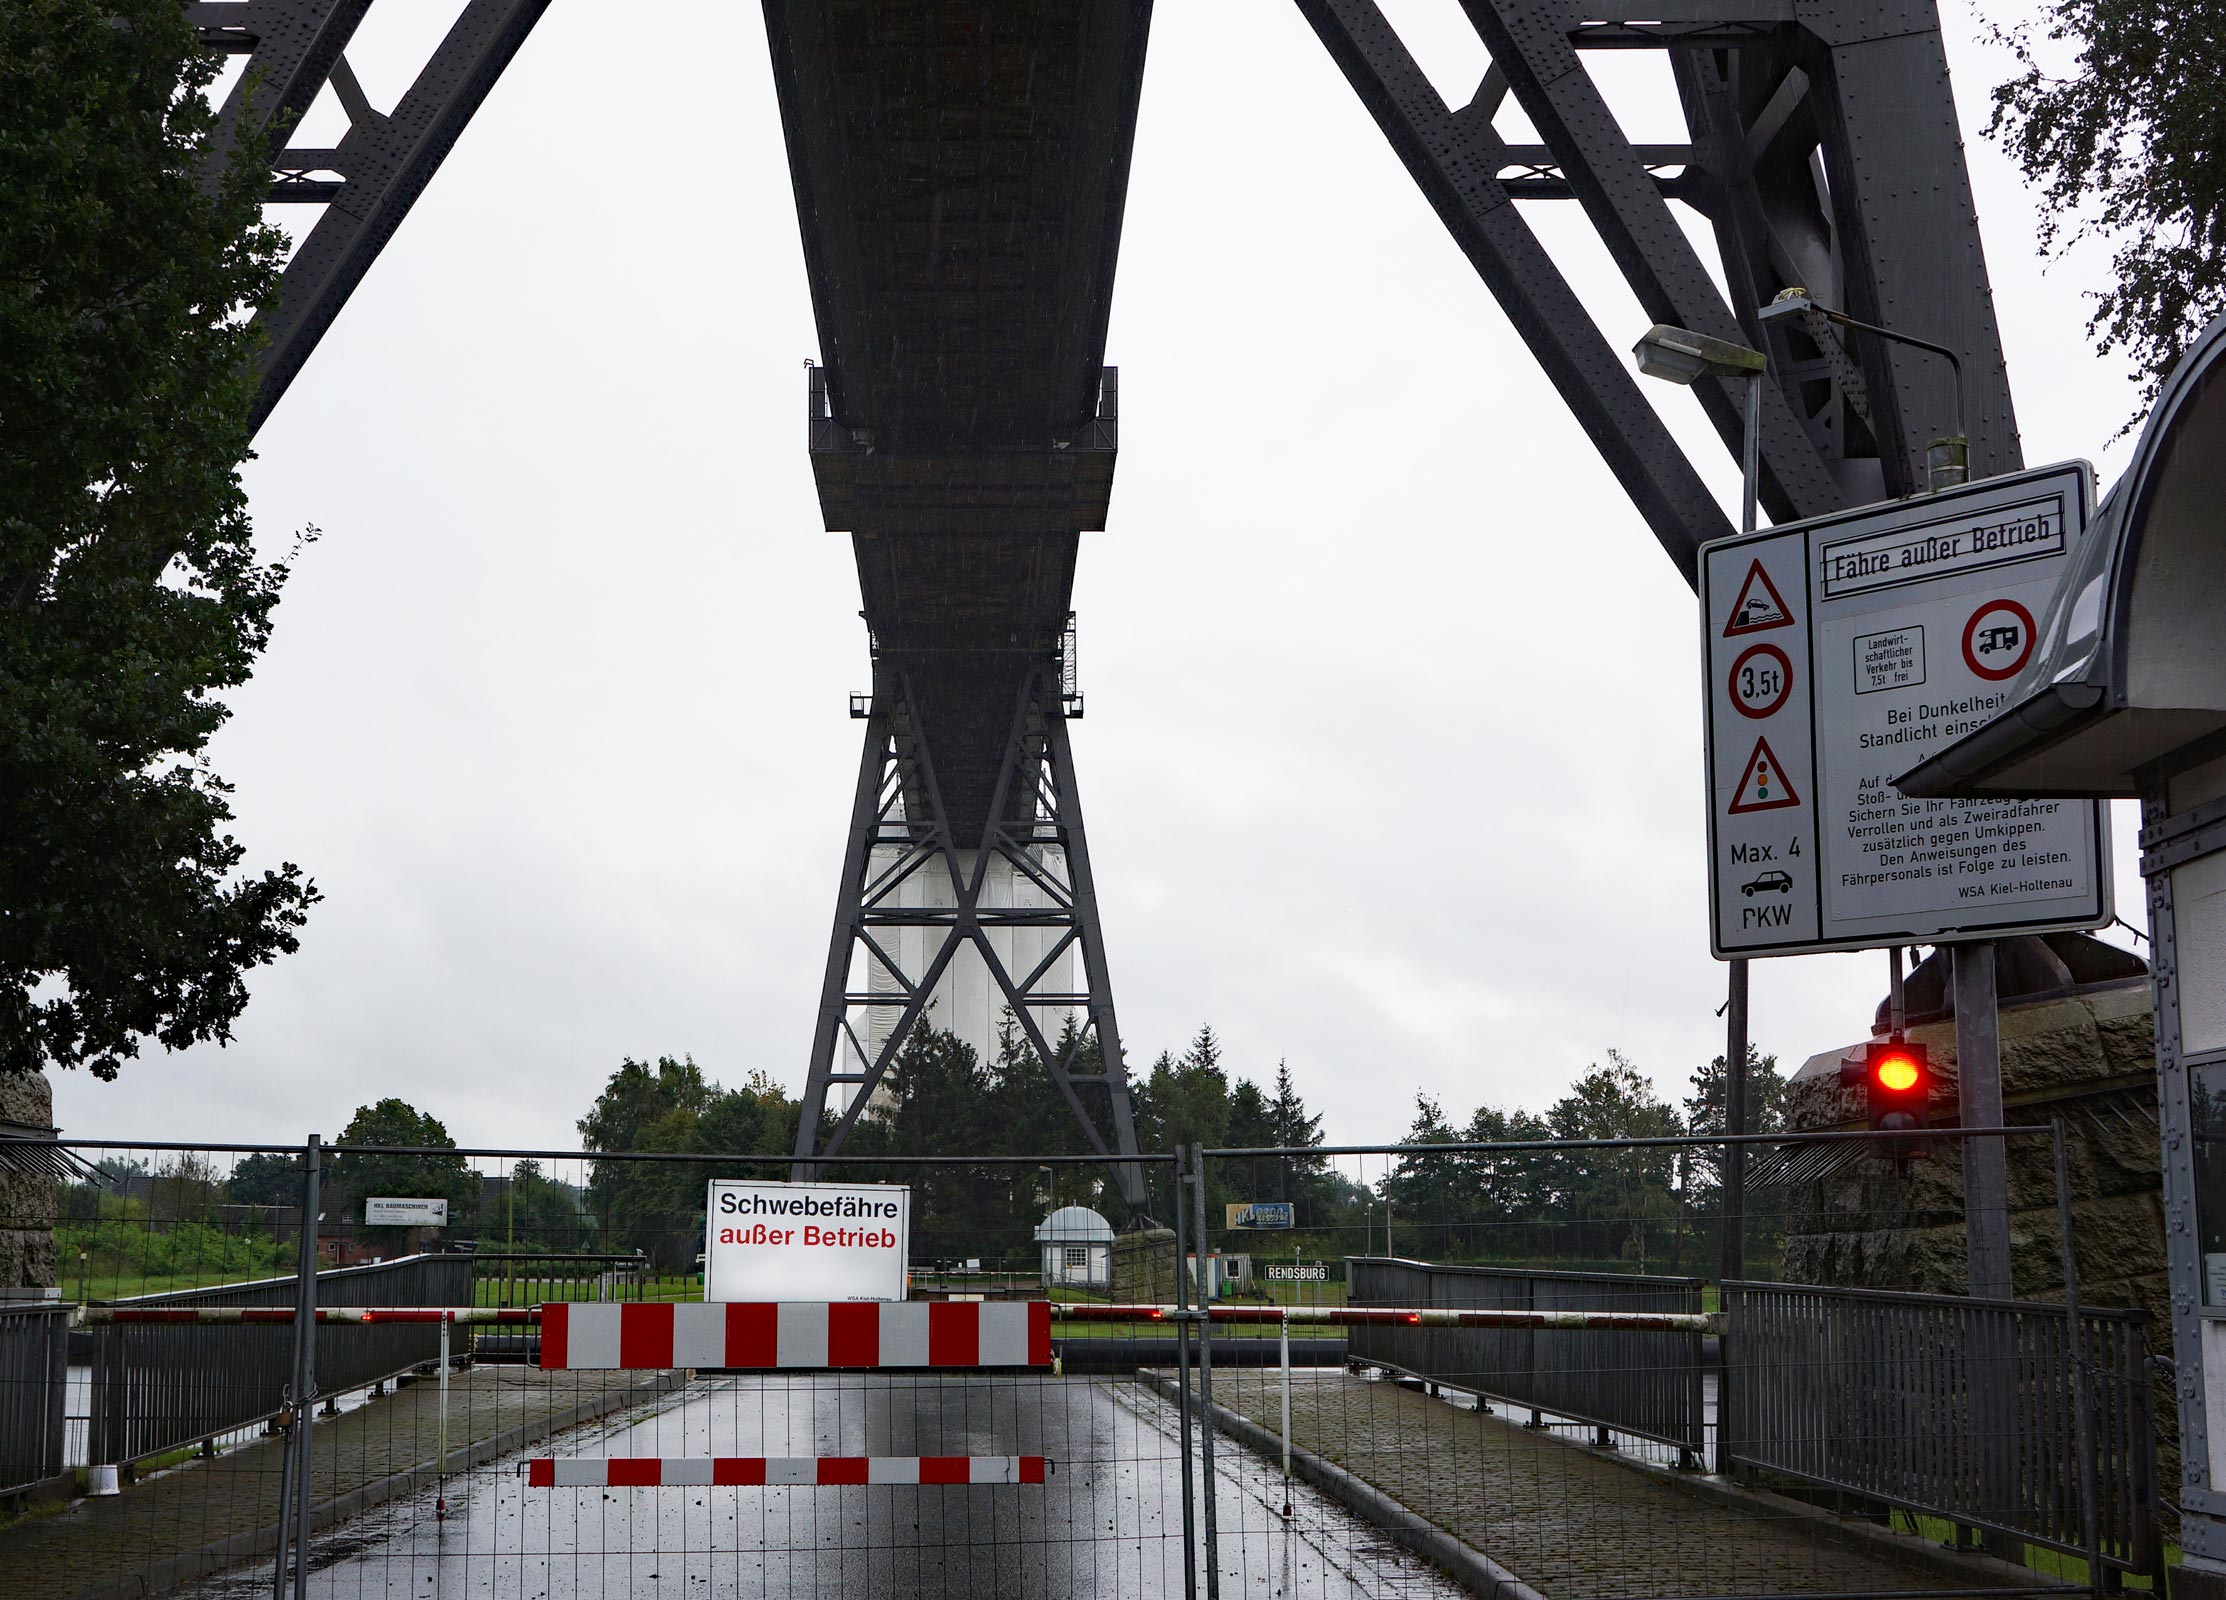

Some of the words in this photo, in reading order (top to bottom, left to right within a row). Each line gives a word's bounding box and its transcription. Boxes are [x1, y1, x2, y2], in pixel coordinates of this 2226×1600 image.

[1834, 551, 1890, 582] Fähre
[1900, 536, 1961, 567] außer
[1971, 513, 2050, 554] Betrieb
[1864, 646, 1913, 663] schaftlicher
[1868, 634, 1908, 650] Landwirt-
[1865, 661, 1897, 675] Verkehr
[1901, 657, 1913, 669] bis
[1871, 674, 1886, 687] 7,5t
[1894, 670, 1909, 682] frei
[1741, 666, 1780, 699] 3,5t
[1887, 706, 1912, 725] Bei
[1919, 692, 2006, 720] Dunkelheit
[1859, 724, 1938, 749] Standlicht
[1859, 776, 1880, 790] Auf
[1849, 807, 1896, 823] Sichern
[1901, 802, 1921, 816] Sie
[1926, 800, 1944, 813] Ihr
[1857, 791, 1891, 806] Stoß-
[1847, 822, 1905, 838] Verrollen
[1910, 816, 1933, 831] und
[1939, 814, 1958, 828] als
[1963, 803, 2060, 824] Zweiradfahrer
[1731, 842, 1778, 865] Max.
[1788, 836, 1801, 858] 4
[1862, 834, 1925, 853] zusätzlich
[1930, 831, 1969, 848] gegen
[1975, 822, 2046, 839] Umkippen.
[1880, 854, 1904, 866] Den
[1910, 844, 1997, 863] Anweisungen
[2002, 839, 2027, 852] des
[1842, 865, 1932, 887] Fährpersonals
[1937, 863, 1953, 876] ist
[1959, 860, 1995, 875] Folge
[2001, 858, 2016, 869] zu
[2021, 852, 2072, 867] leisten.
[1958, 885, 1985, 898] WSA
[1990, 878, 2073, 896] Kiel-Holtenau
[1742, 903, 1792, 929] PKW
[720, 1192, 898, 1219] Schwebefähre
[719, 1223, 796, 1246] außer
[803, 1225, 897, 1249] Betrieb
[1268, 1267, 1326, 1280] RENDSBURG
